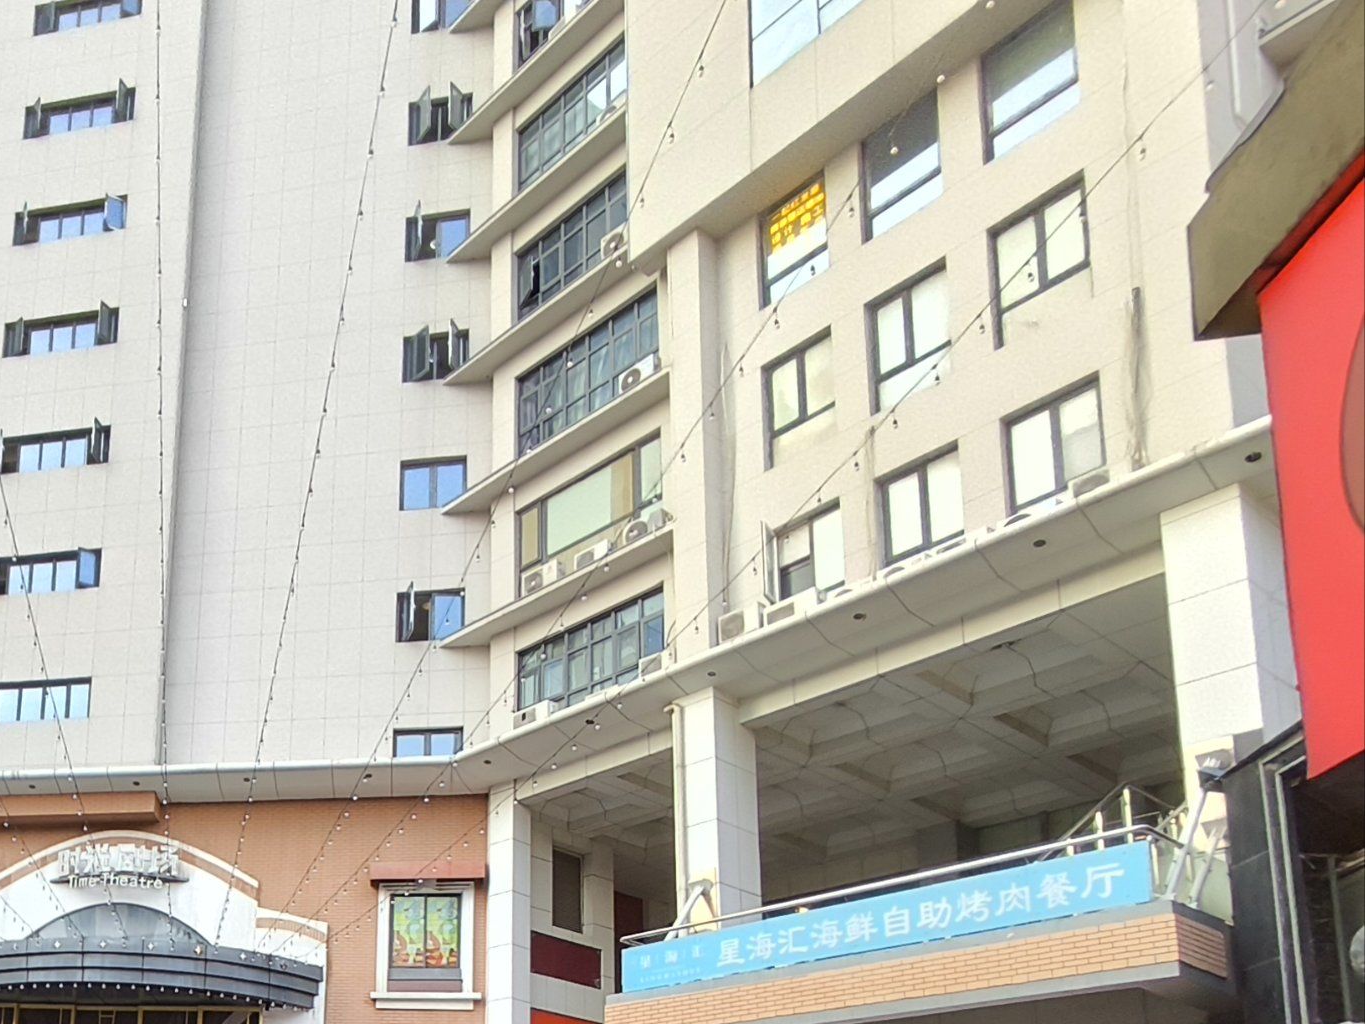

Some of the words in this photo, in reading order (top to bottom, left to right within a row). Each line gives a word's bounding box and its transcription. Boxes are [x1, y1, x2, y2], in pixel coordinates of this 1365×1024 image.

[68, 874, 101, 888] Time
[101, 872, 164, 889] Theatre
[716, 862, 1126, 967] 星海汇海鲜自助烤肉餐厅
